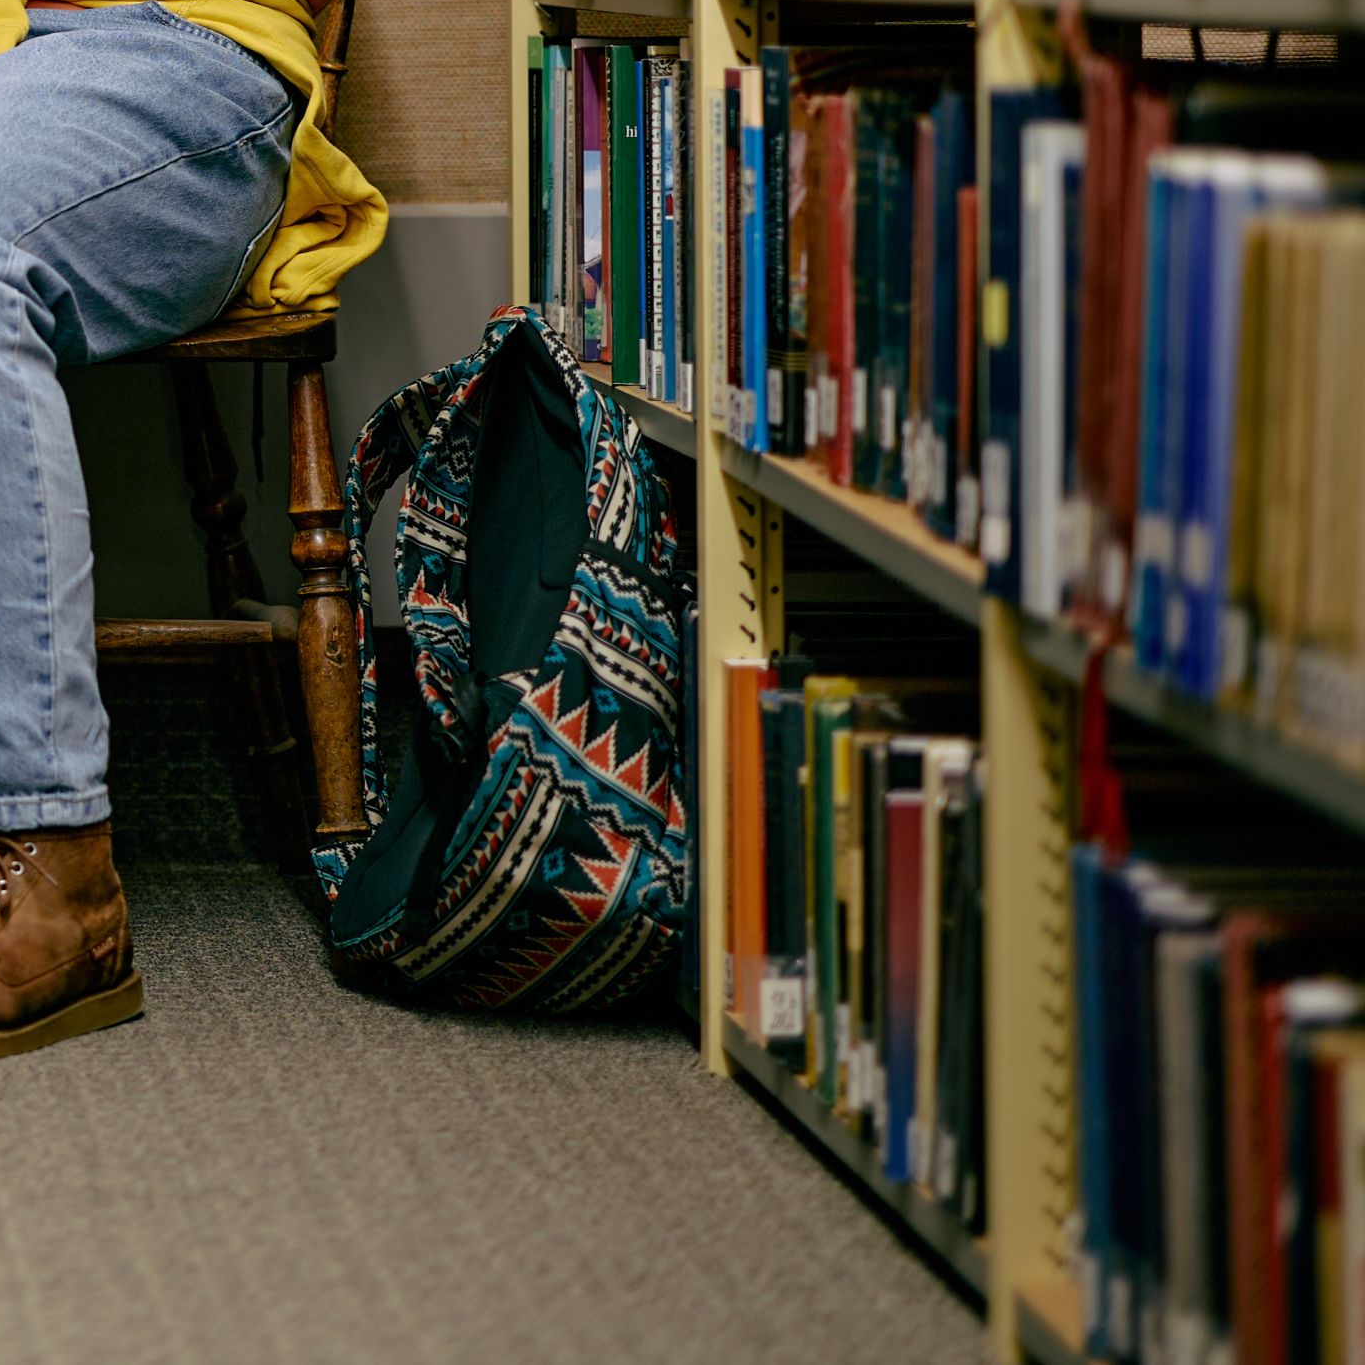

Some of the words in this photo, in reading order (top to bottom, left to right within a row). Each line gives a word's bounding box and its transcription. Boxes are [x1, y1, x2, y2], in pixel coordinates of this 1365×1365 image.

[715, 99, 723, 135] THE
[715, 143, 723, 205] STUDY
[715, 211, 723, 236] OF
[715, 242, 723, 362] SPIRITUALITY
